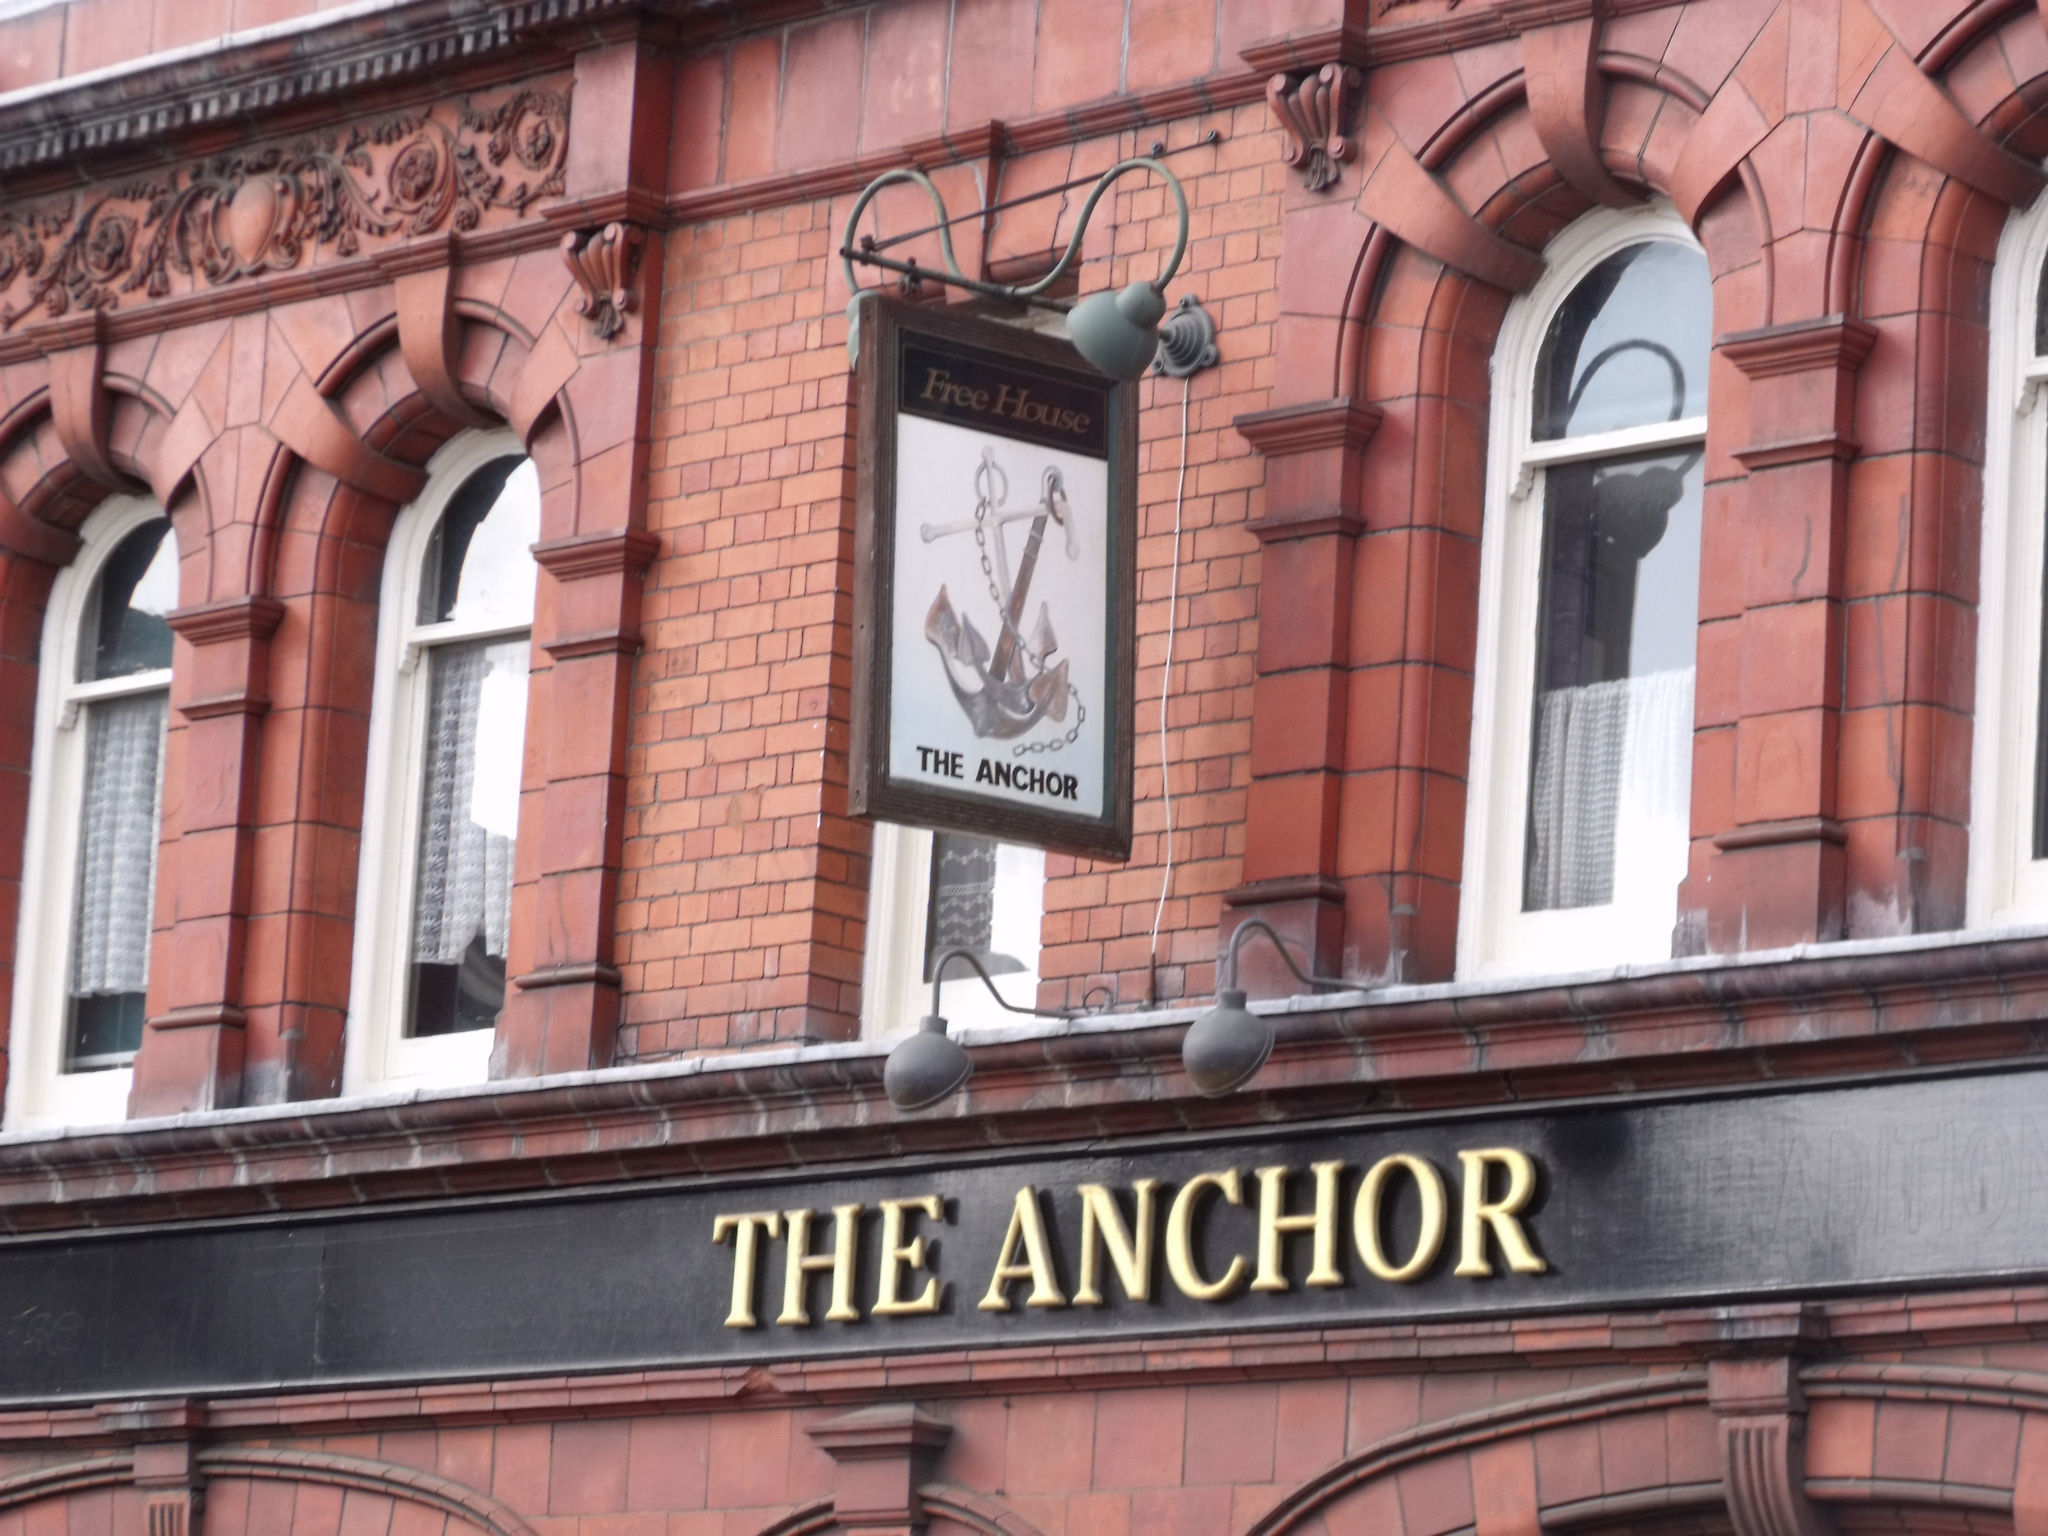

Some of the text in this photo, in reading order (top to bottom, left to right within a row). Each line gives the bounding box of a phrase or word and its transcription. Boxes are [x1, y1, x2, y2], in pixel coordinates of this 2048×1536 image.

[920, 367, 1090, 434] Free House
[916, 745, 1078, 800] THE ANCHOR
[713, 1147, 1546, 1328] THE ANCHOR
